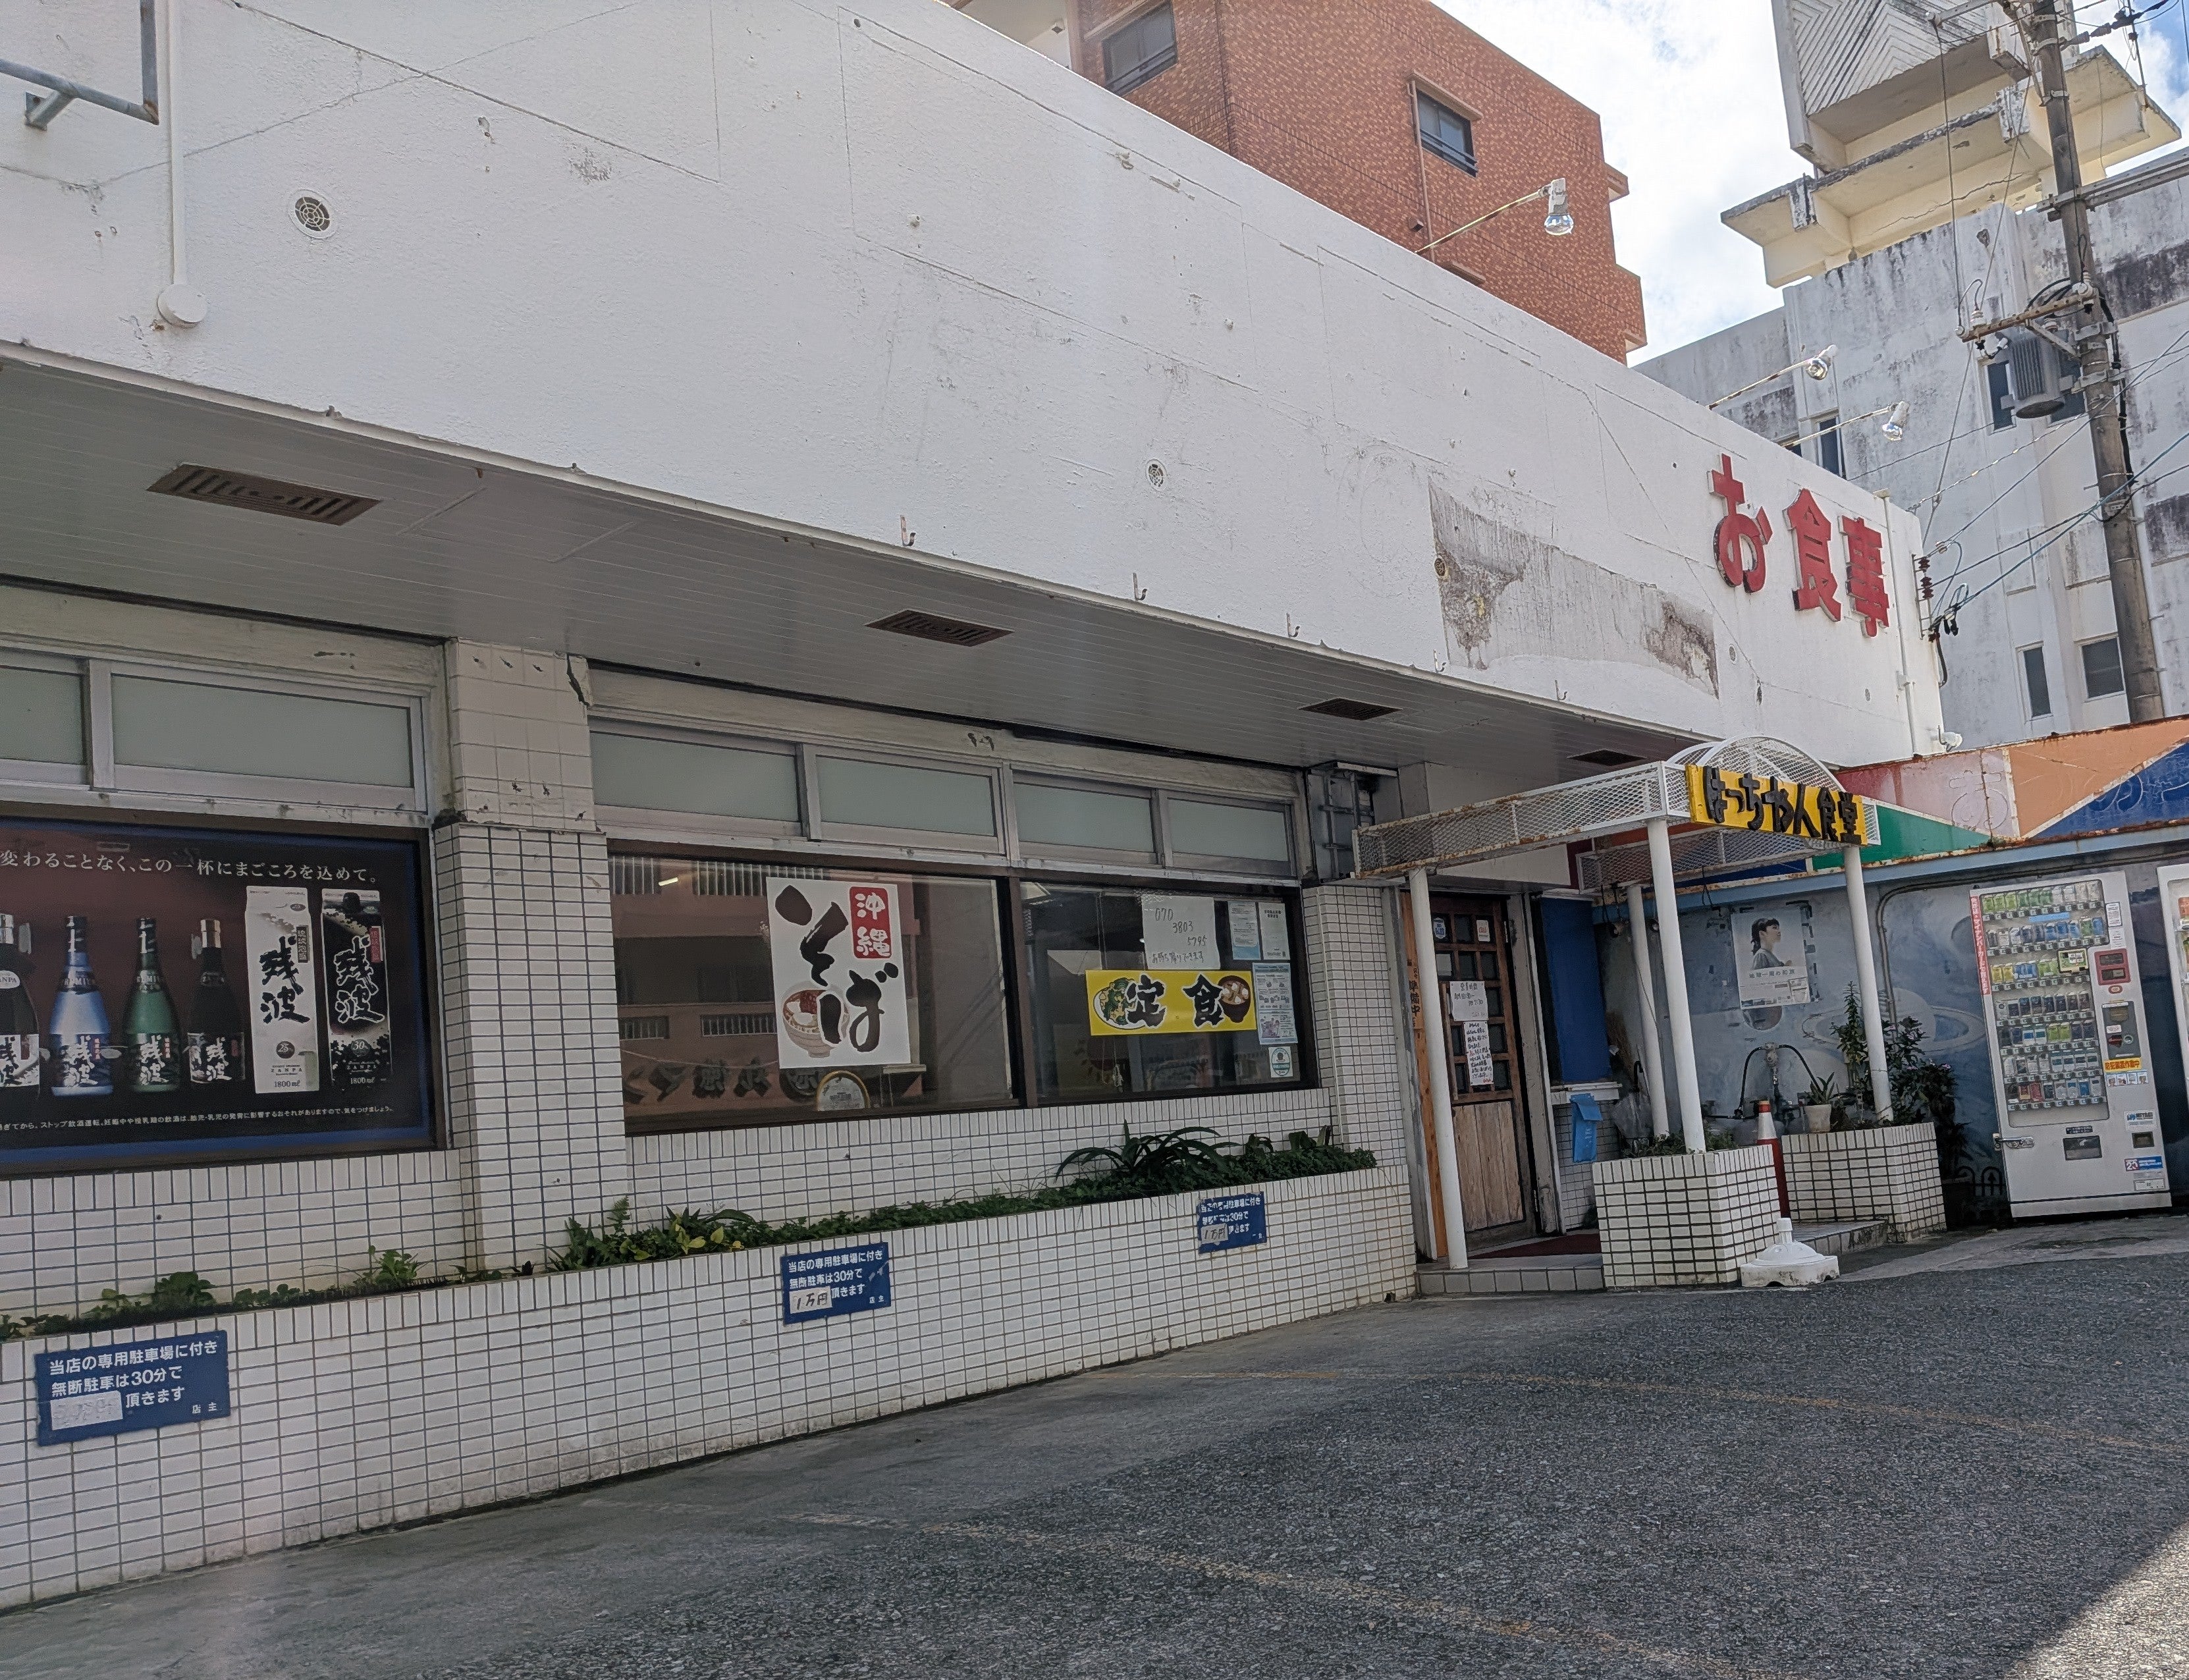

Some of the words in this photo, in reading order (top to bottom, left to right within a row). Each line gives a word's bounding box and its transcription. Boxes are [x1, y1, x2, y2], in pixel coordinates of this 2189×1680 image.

[1708, 453, 1889, 637] お食事
[0, 850, 376, 883] 変わることなく、この一杯にまごころを込めて。
[856, 892, 892, 957] 沖縄
[1155, 908, 1174, 921] 070
[1173, 921, 1193, 933] 3803
[259, 936, 310, 1023] 残波
[333, 935, 385, 1023] 残波
[775, 884, 899, 1052] そば
[1125, 973, 1225, 1029] 定食
[788, 1249, 883, 1273] 当店の専用駐車場に付き
[790, 1268, 863, 1289] 無断駐車は30分で
[796, 1292, 828, 1310] 1万円
[831, 1284, 865, 1299] 頂きます
[49, 1340, 218, 1375] 当店の専用駐車場に付き
[51, 1366, 182, 1397] 無断駐車は30分で
[125, 1386, 186, 1408] 頂きます
